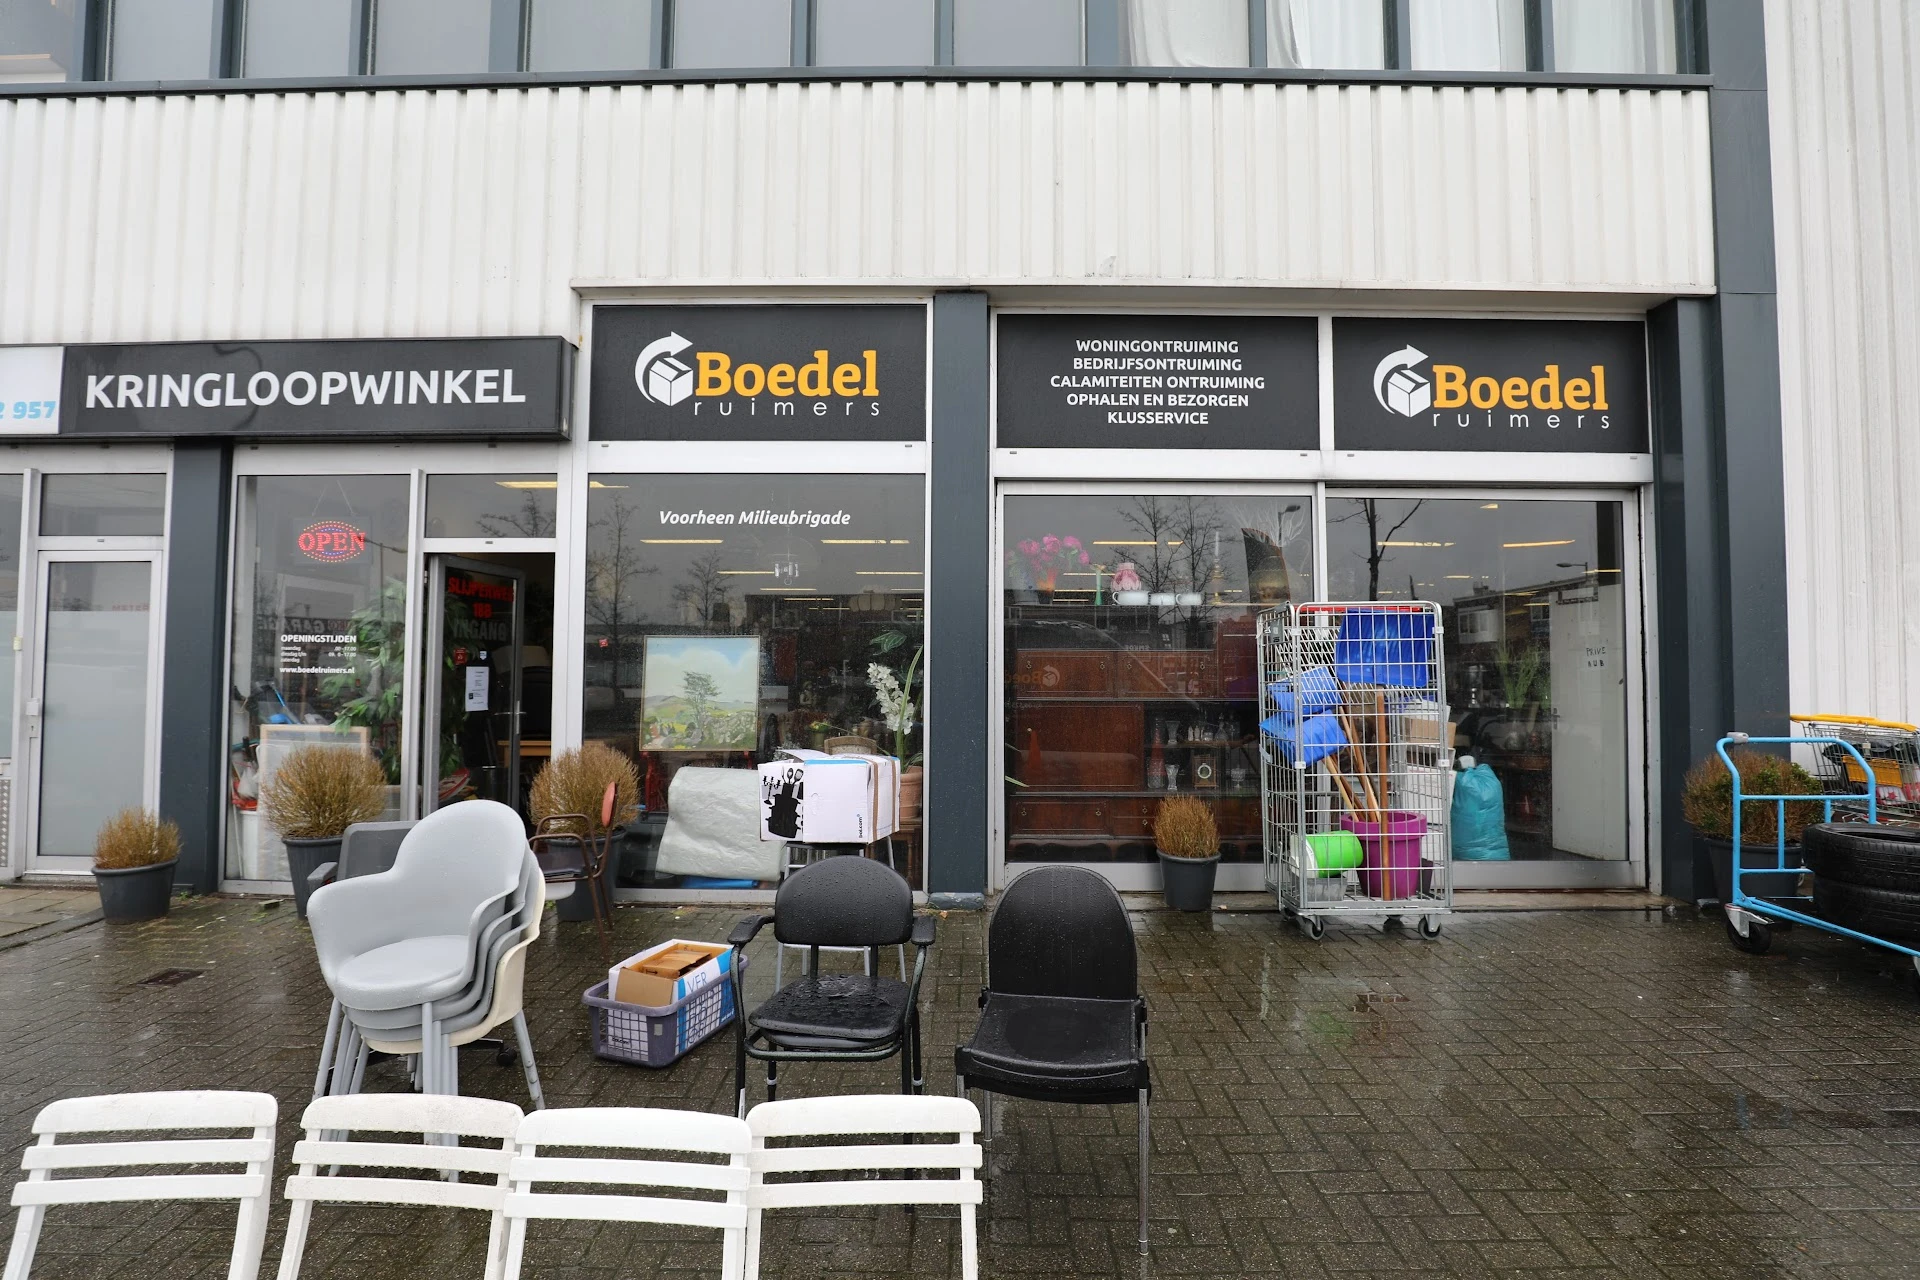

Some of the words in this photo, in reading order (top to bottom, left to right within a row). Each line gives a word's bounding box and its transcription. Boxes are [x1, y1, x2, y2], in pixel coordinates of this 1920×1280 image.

[1076, 339, 1239, 353] WONINGONTRUIMING
[1073, 358, 1242, 371] BEDRIJFSONTRUIMING
[695, 350, 879, 397] Boedel
[1050, 375, 1163, 388] CALAMITEITEN
[1166, 376, 1265, 389] ONTRUIMING
[85, 368, 526, 409] KRINGLOOPWINKEL
[1432, 364, 1608, 411] Boedel
[694, 397, 880, 416] ruimers
[1066, 393, 1139, 406] OPHALEN
[1143, 393, 1163, 406] EN
[1167, 394, 1249, 407] BEZORGEN
[12, 400, 56, 419] 957
[1107, 411, 1209, 424] KLUSSERVICE
[1433, 409, 1610, 429] ruimers
[659, 510, 734, 525] Voorheen
[738, 510, 850, 527] Milieubrigade
[298, 532, 366, 551] OPEN
[280, 634, 357, 643] OPENINGSTIJDEN
[279, 666, 355, 674] www.boedelruimers.nl
